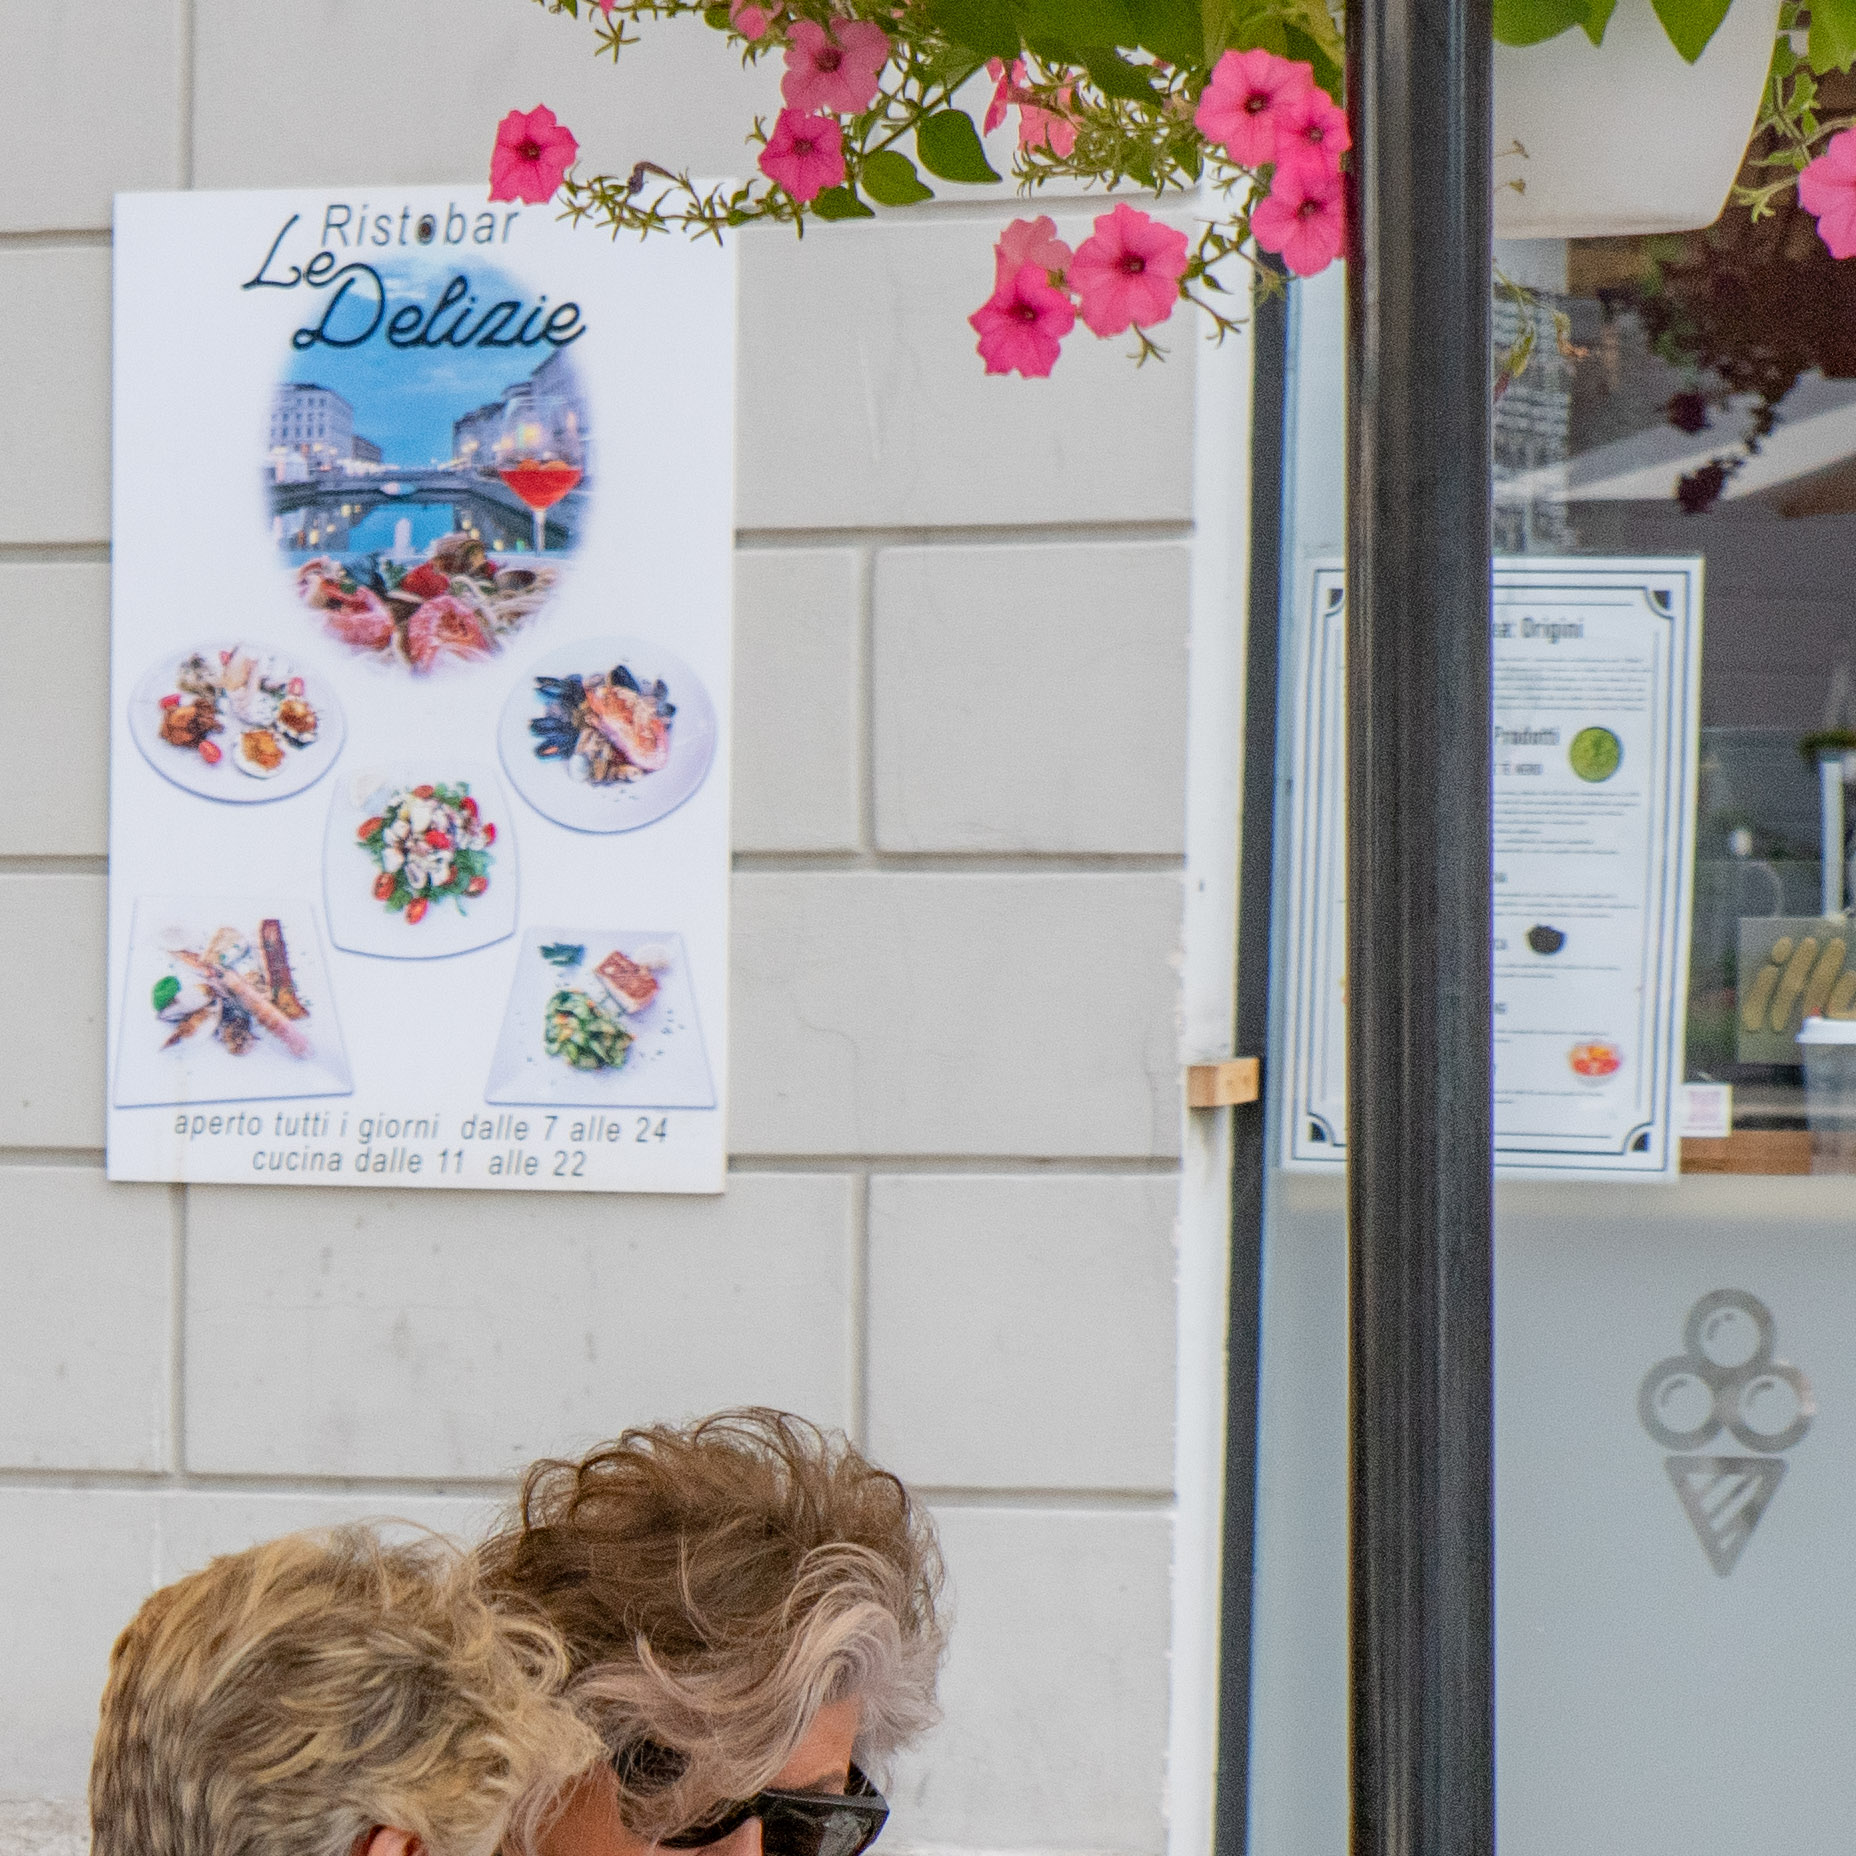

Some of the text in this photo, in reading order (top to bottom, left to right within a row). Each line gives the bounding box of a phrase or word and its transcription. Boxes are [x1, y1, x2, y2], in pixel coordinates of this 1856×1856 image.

[321, 203, 519, 246] Ristobar
[242, 213, 337, 289] Le
[292, 262, 587, 350] Delizie
[175, 1112, 668, 1144] aperto tutti i giorni dalle 7 alle 24
[252, 1146, 587, 1177] cucina dalle 11 alle 22
